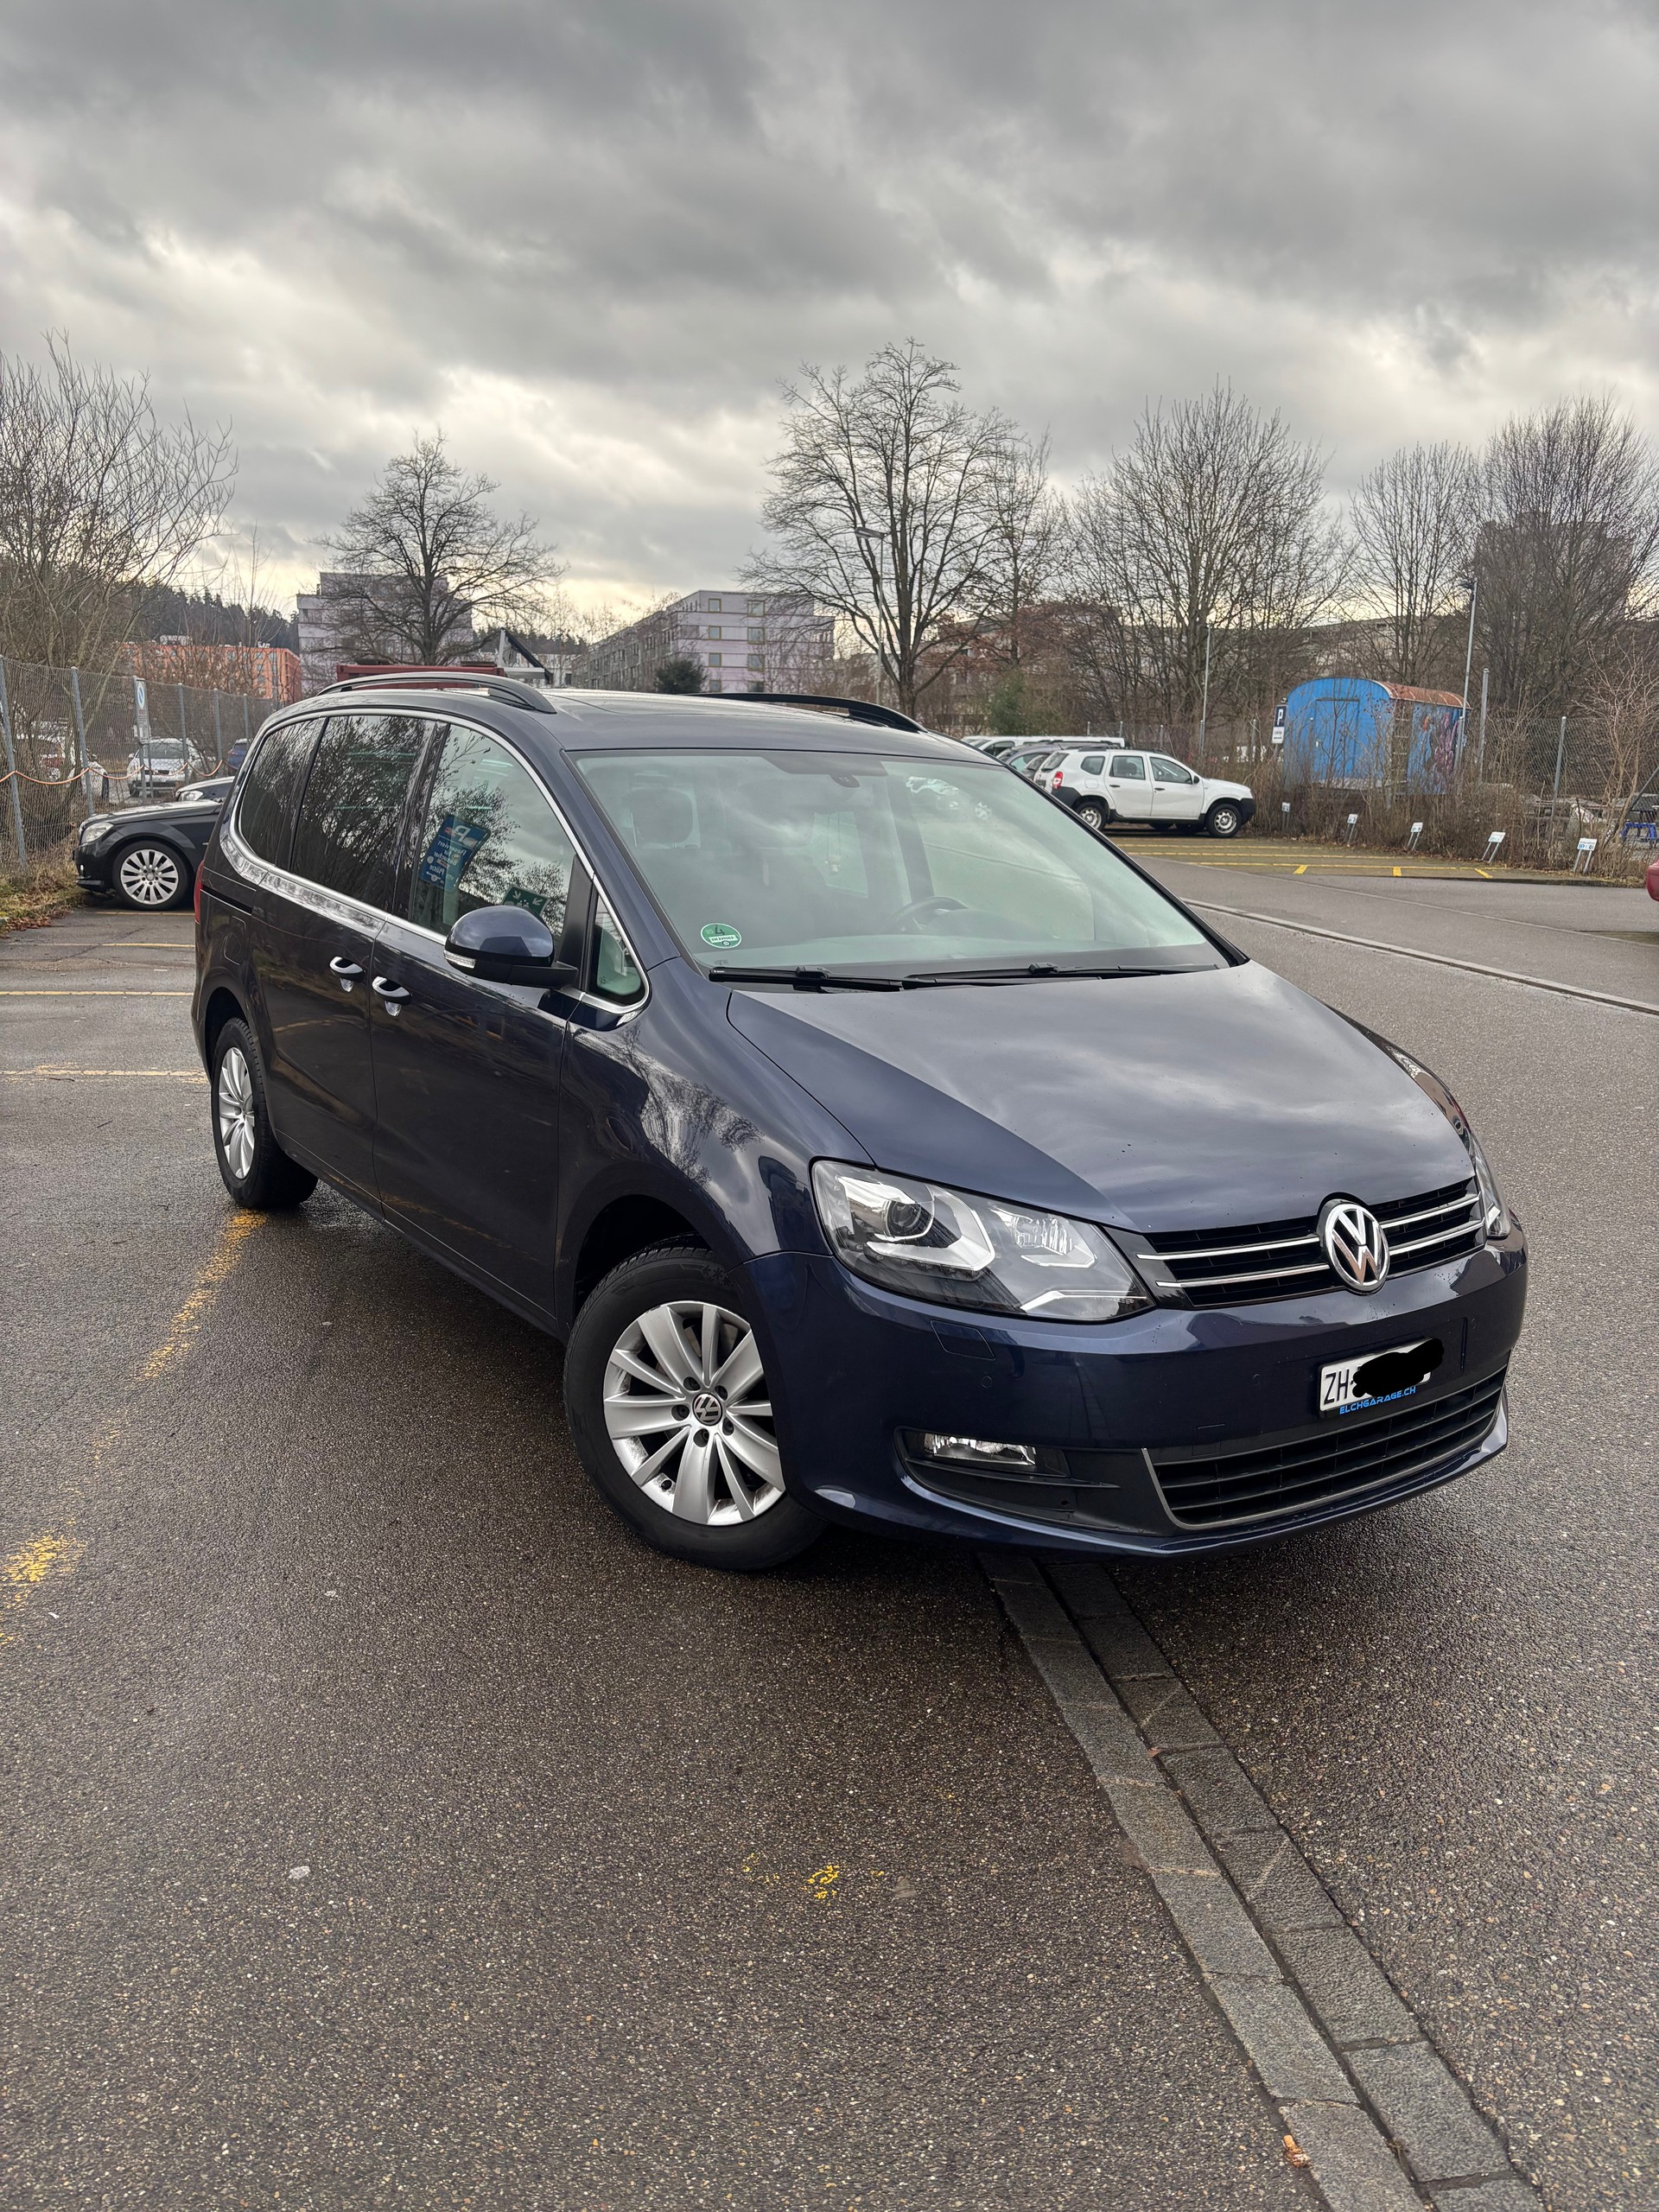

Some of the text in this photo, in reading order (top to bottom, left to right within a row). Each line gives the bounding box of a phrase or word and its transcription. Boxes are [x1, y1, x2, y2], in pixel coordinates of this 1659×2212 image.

[1277, 709, 1283, 726] P
[1326, 1204, 1389, 1289] VW
[1339, 1385, 1416, 1414] ELCHGARAGE.CH
